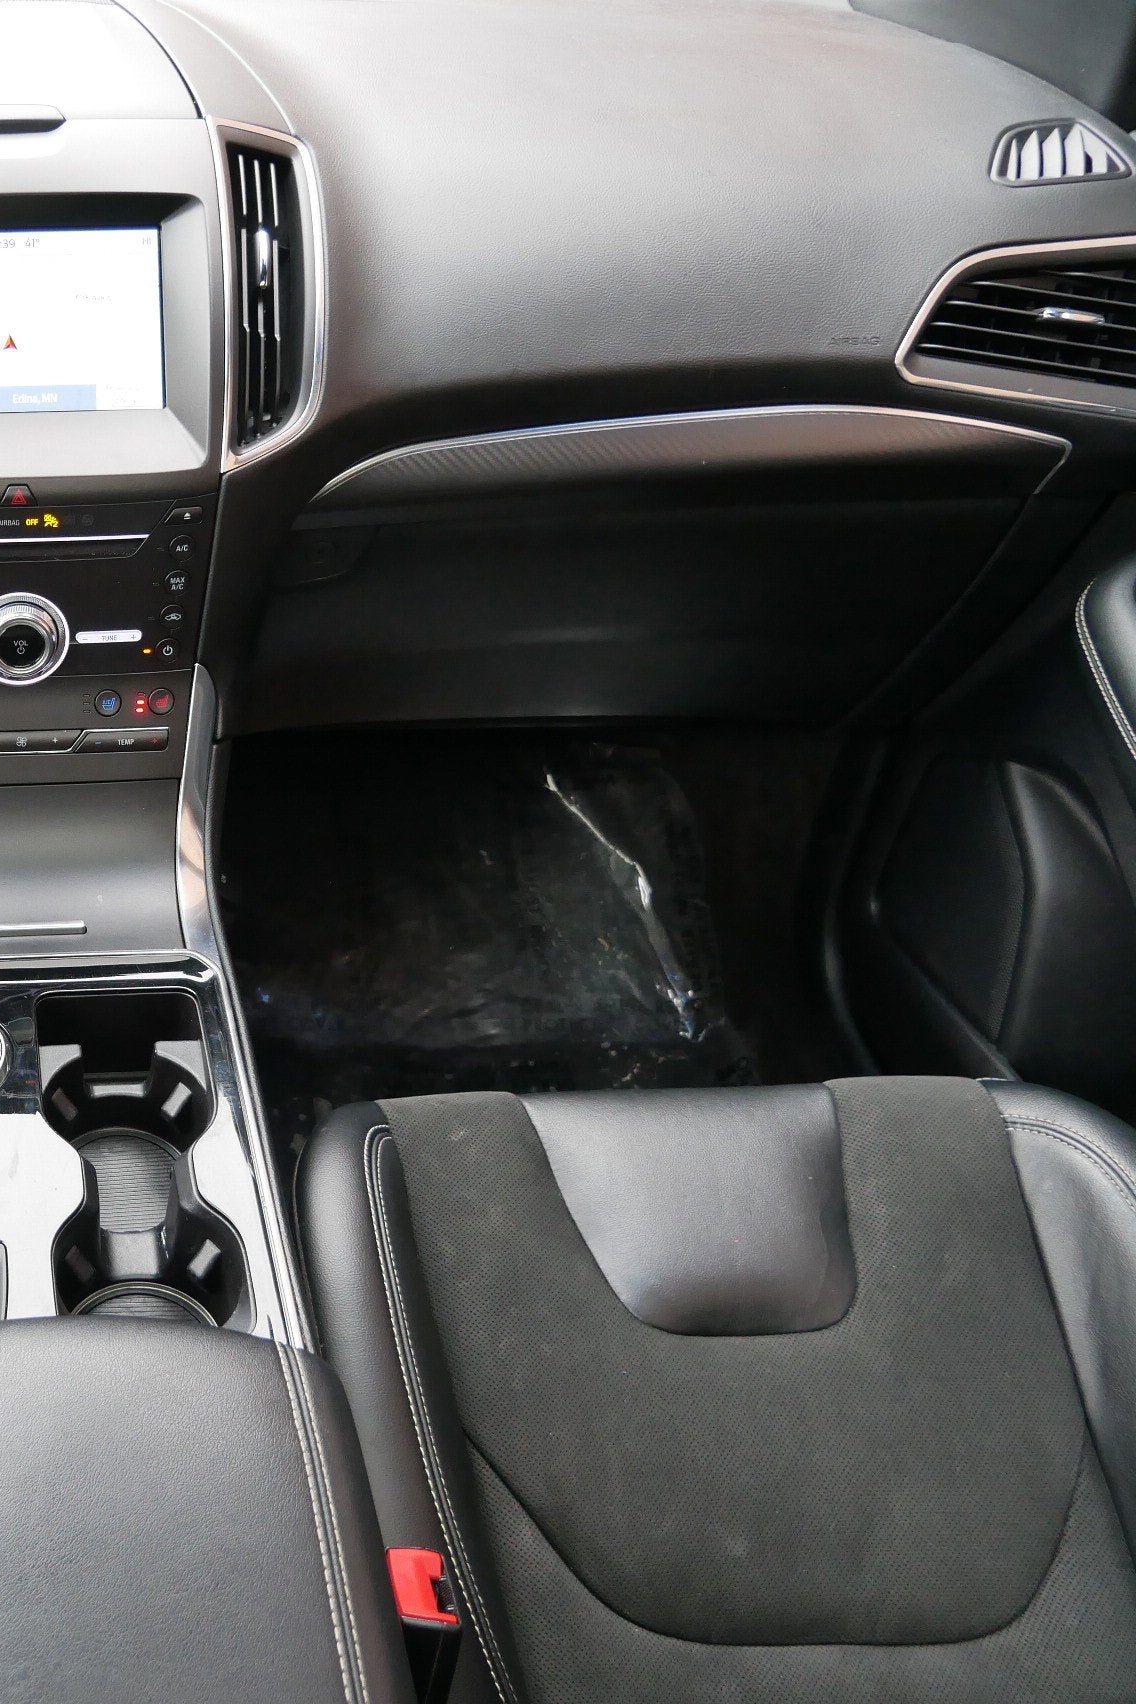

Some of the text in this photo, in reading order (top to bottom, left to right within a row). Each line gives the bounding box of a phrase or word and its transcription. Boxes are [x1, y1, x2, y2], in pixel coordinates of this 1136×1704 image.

[41, 393, 58, 403] MN
[13, 640, 29, 648] VOL
[118, 738, 135, 746] TEMP
